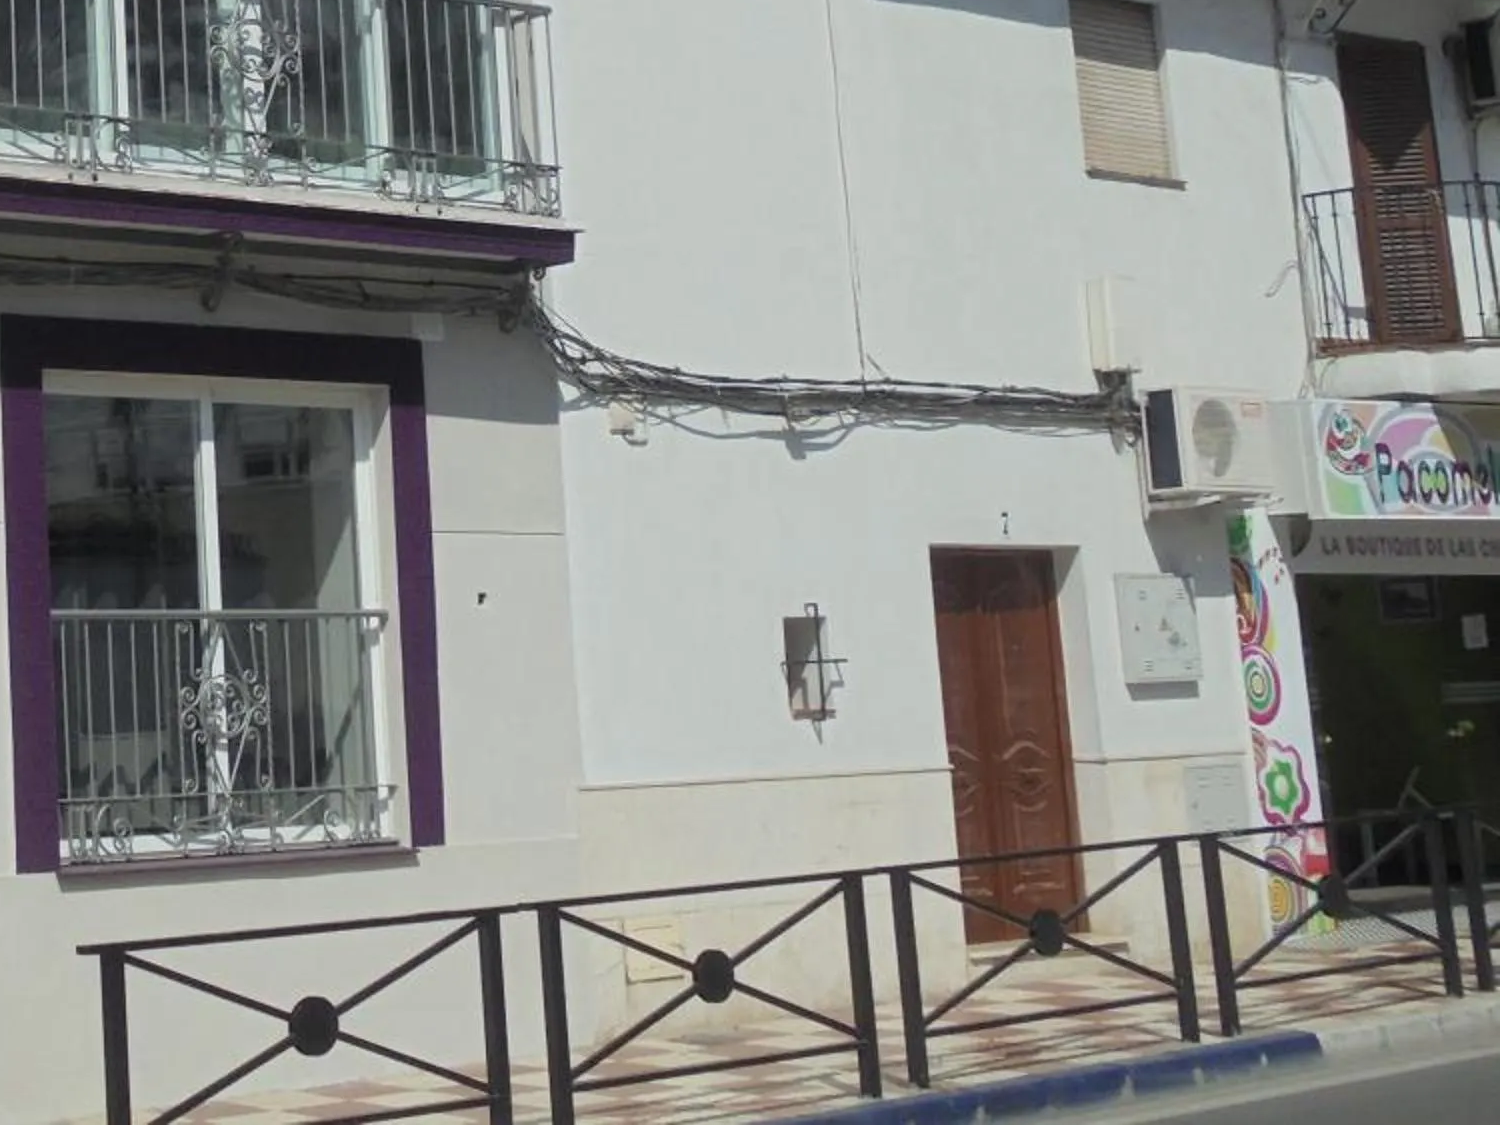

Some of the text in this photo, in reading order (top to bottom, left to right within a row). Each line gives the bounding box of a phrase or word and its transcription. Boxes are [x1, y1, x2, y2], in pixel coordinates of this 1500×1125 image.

[1320, 536, 1341, 556] LA
[1345, 536, 1422, 556] BOUTIQUE
[1425, 536, 1445, 557] DE
[1448, 536, 1476, 557] LAS
